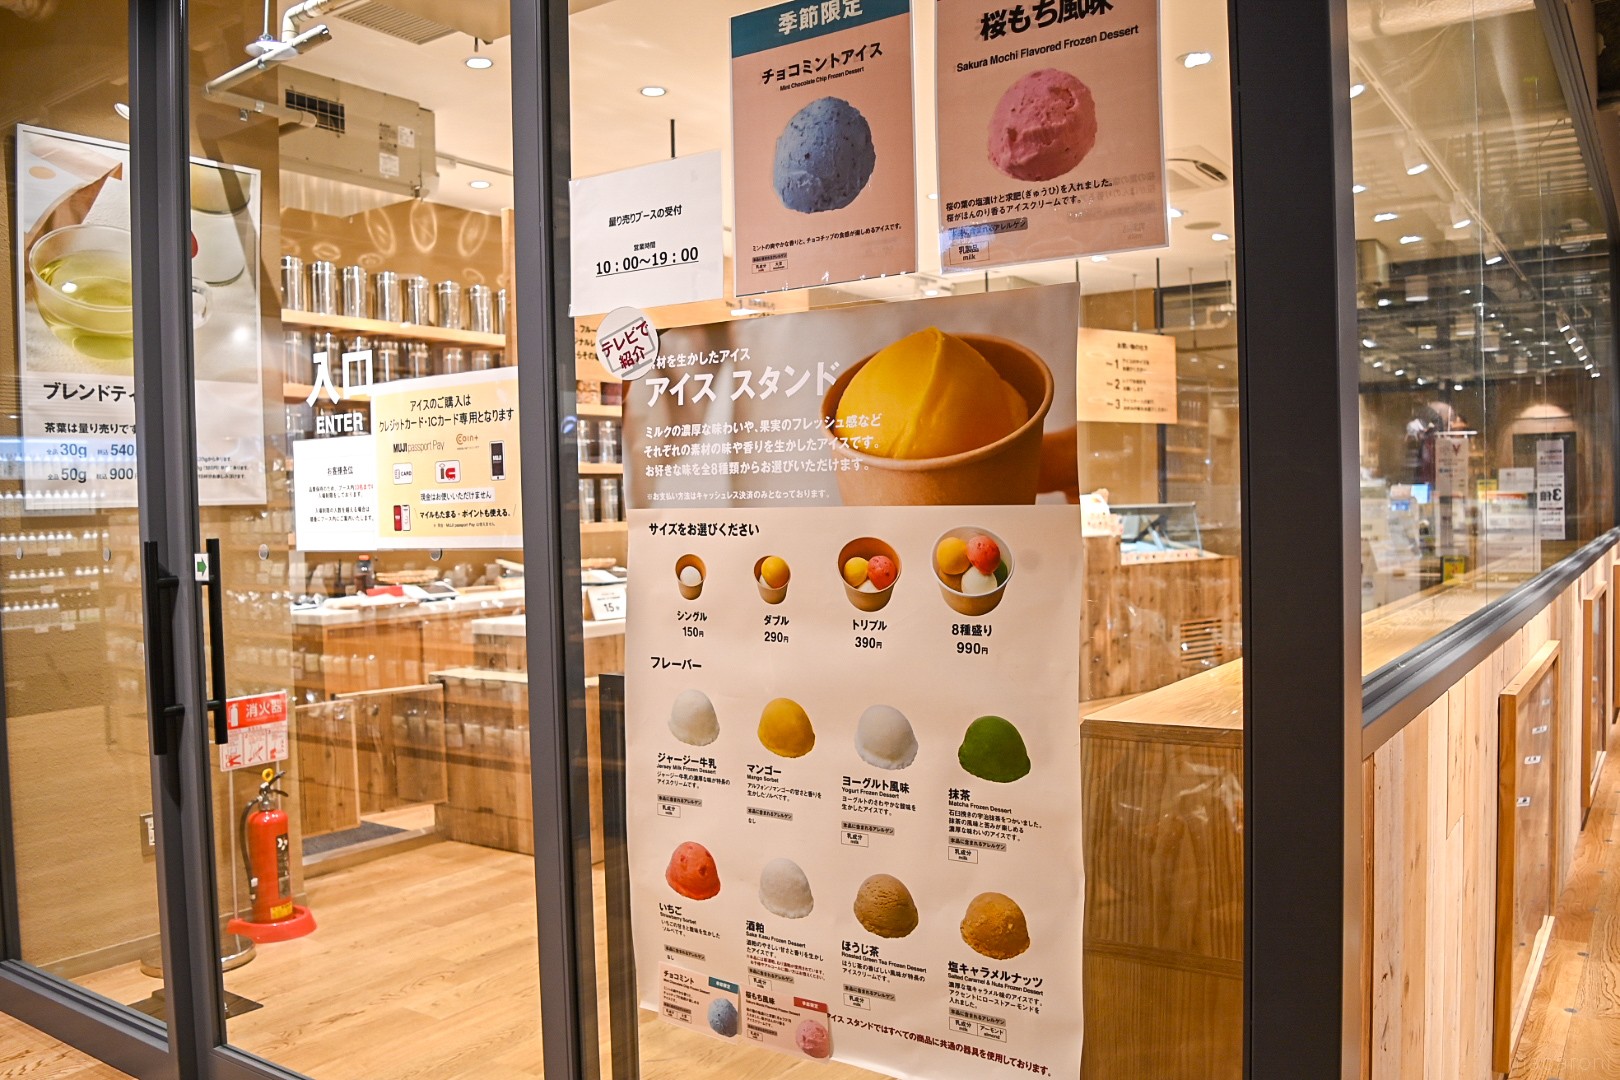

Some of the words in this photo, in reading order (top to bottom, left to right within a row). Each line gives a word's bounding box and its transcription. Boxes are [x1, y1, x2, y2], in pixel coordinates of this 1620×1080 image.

[778, 0, 862, 35] 季節限定
[956, 59, 988, 72] Sakura
[990, 51, 1018, 66] Mochi
[1020, 41, 1062, 58] Flavored
[1064, 36, 1097, 50] Frozen
[1100, 24, 1139, 42] Dessert
[762, 42, 883, 84] チョコミントアイス
[608, 204, 682, 227] 量り売りブースの受付
[946, 195, 1082, 222] 桜がほんのり香るアイスクリームです。
[634, 241, 656, 251] 営業時間
[602, 320, 648, 357] テレビで
[619, 345, 644, 369] 紹介
[651, 348, 751, 370] 材を生かしたアイス
[306, 350, 373, 407] 入口
[646, 372, 717, 408] アイス
[731, 361, 839, 401] スタンド
[410, 394, 471, 412] アイスのご購入は
[316, 412, 363, 434] ENTER
[380, 408, 514, 432] クレジットカード・ICカード専用となります
[646, 413, 882, 439] ミルクの濃厚な味わいや、果実のフレッシュ感など
[60, 444, 87, 458] 30g
[110, 444, 134, 456] 540
[393, 442, 408, 452] MUJI
[408, 442, 432, 452] passport
[432, 440, 444, 450] Pay
[644, 435, 880, 458] それぞれの素材の味や香りを生かしたアイスです。
[61, 468, 86, 483] 50g
[110, 468, 136, 480] 900
[646, 457, 869, 478] お好きな味を全8種類からお選びいただけます。
[420, 491, 492, 502] 現金はお使いいただけません
[649, 522, 760, 536] サイズをお選びください
[677, 611, 708, 622] シングル
[764, 615, 790, 626] ダブル
[682, 626, 704, 638] 150円
[852, 620, 888, 631] トリプル
[952, 624, 992, 637] 8種盛り
[764, 632, 789, 643] 290円
[855, 637, 882, 649] 390円
[956, 642, 988, 655] 990円
[650, 656, 702, 670] フレーバー
[246, 699, 282, 718] 消火器
[658, 752, 716, 769] ジャージー牛乳
[747, 764, 782, 775] マンゴー
[842, 776, 910, 794] ヨーグルト風味
[842, 786, 859, 794] Yogurt
[948, 788, 970, 801] 抹茶
[842, 796, 916, 812] ヨーグルトのさわやかな酸味を
[842, 804, 892, 816] 生かしたアイスです。
[948, 800, 969, 808] Matcha
[990, 806, 1012, 814] Dessert
[948, 809, 1042, 828] 石臼挽きの宇治抹茶をつかいました。
[948, 818, 1024, 834] 抹茶の風味と苦みが楽しめる
[948, 826, 1021, 842] 濃厚な味わいのアイスです。
[659, 902, 682, 916] いちご
[746, 920, 764, 933] 酒粕
[771, 936, 786, 944] Frozen
[788, 940, 806, 948] Dessert
[842, 940, 879, 957] ほうじ茶
[746, 947, 776, 958] たアイスです。
[842, 952, 862, 960] Roasted
[879, 958, 888, 966] Tea
[888, 960, 906, 968] Frozen
[907, 965, 926, 973] Dessert
[664, 970, 694, 984] チョコミント
[842, 960, 925, 982] ほうじ茶の香ばしい風味が特長の
[843, 968, 890, 982] アイスクリームです。
[948, 961, 1043, 988] 塩キャラメルナッツ
[948, 982, 1042, 1006] 濃厚な塩キャラメル味のアイスです。
[964, 976, 985, 985] Caramel
[1004, 984, 1022, 992] Frozen
[1023, 986, 1044, 996] Dessert
[746, 991, 776, 1004] 桜もち風味
[949, 990, 1040, 1014] アクセントにローストアーモンドを
[949, 998, 978, 1008] 入れました。
[980, 1026, 1004, 1036] アーモンド
[846, 1017, 1051, 1076] スタンドではすべての商品に共通の器具を使用しております。
